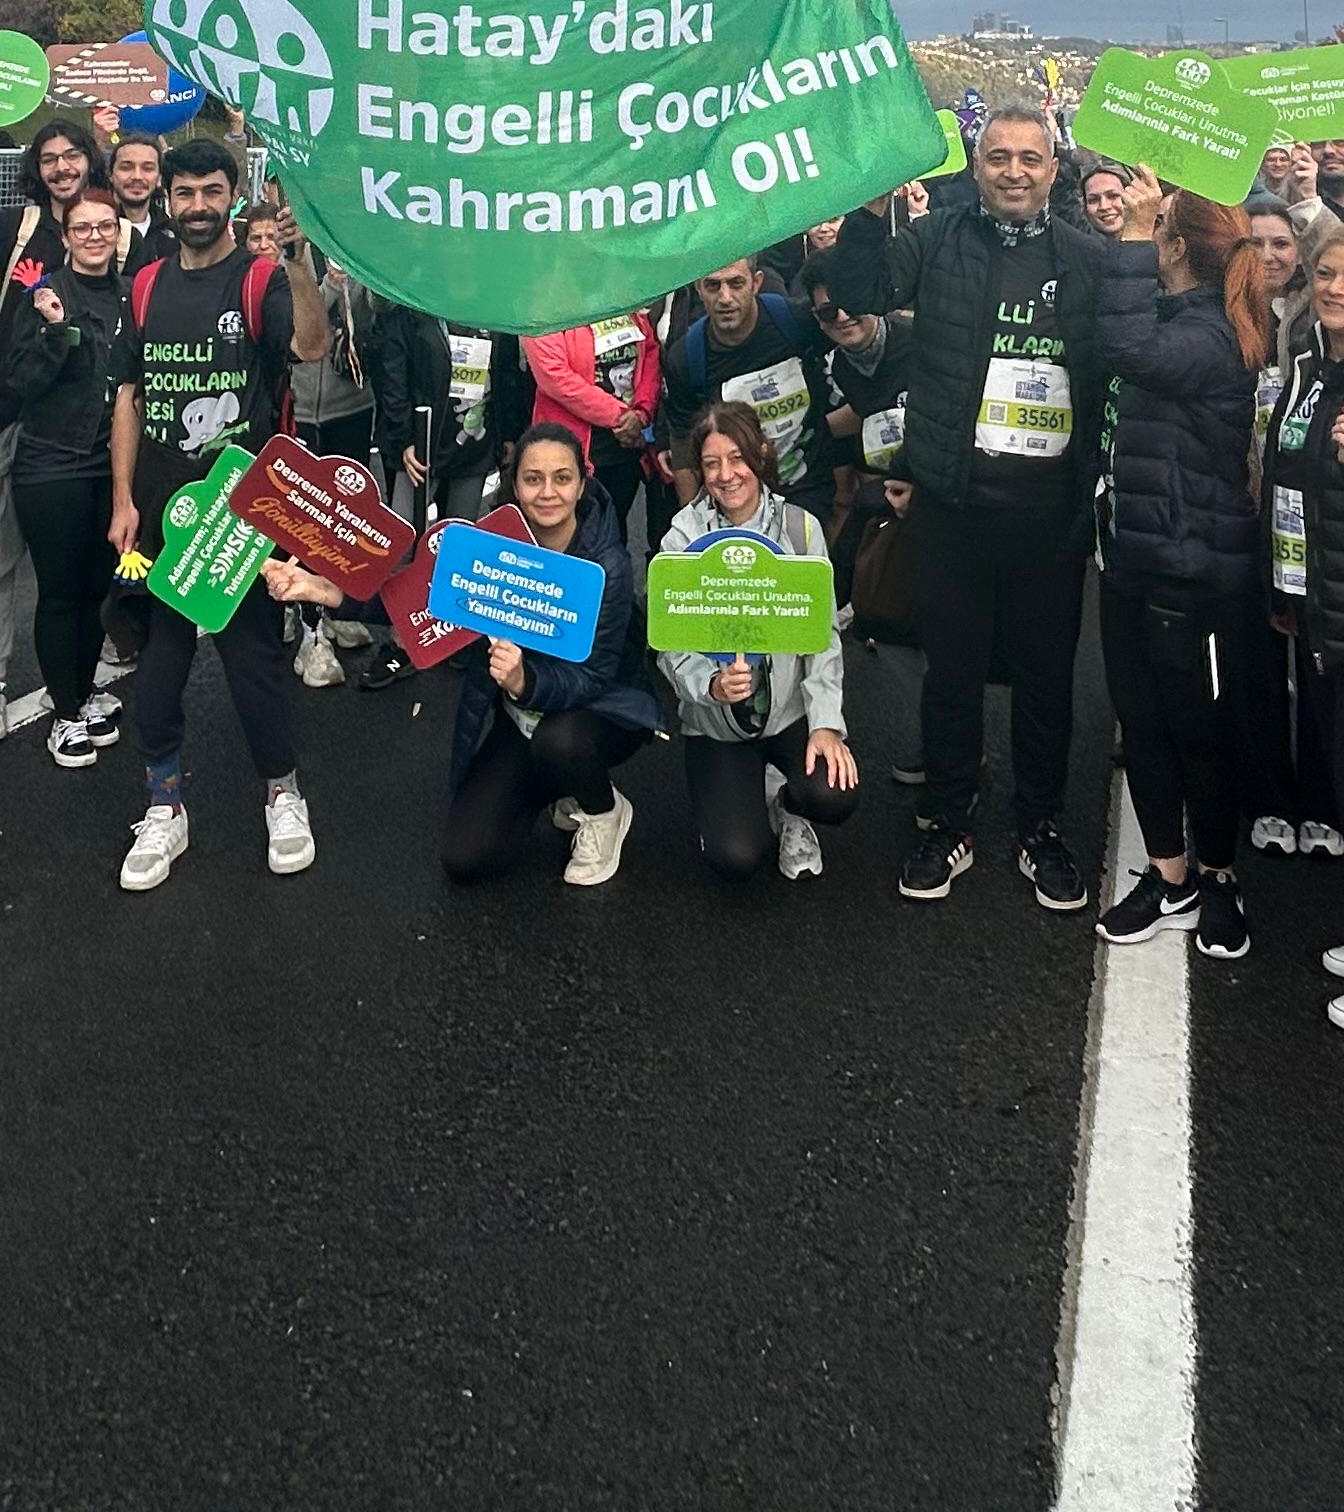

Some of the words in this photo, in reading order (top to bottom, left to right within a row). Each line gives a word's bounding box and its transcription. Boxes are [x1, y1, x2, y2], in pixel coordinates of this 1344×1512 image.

[357, 83, 594, 154] Engelli
[617, 34, 899, 151] Çocukların
[1145, 80, 1220, 117] Depremzede
[1101, 99, 1170, 133] Adımlarınla
[1171, 125, 1200, 145] Fark
[1203, 137, 1242, 161] Yarat!
[1104, 82, 1142, 105] Engelli
[1143, 97, 1197, 127] Çocukları
[1198, 118, 1249, 148] Unutma,
[360, 166, 717, 232] Kahramanı
[731, 126, 821, 194] Ol!
[143, 338, 213, 362] ENGELLİ
[144, 369, 248, 396] ÇOCUKLARIN
[758, 393, 805, 419] 40592
[1017, 408, 1066, 429] 35561
[272, 457, 334, 507] Depremin
[333, 500, 392, 549] Yaralarını
[286, 489, 335, 530] Sarmak
[177, 558, 205, 597] Engelli
[199, 511, 233, 560] Çocuklar
[223, 546, 260, 597] Tutunsun
[450, 573, 500, 601] Engelli
[502, 590, 578, 625] Çocukların
[472, 560, 564, 599] Depremzede
[664, 589, 703, 602] Engelli
[706, 590, 760, 603] Çocukları
[701, 576, 777, 588] Depremzede
[467, 598, 555, 638] Yanındayım!
[668, 604, 740, 616] Adımlarınla
[742, 605, 770, 616] Fark
[773, 606, 810, 618] Yarat!
